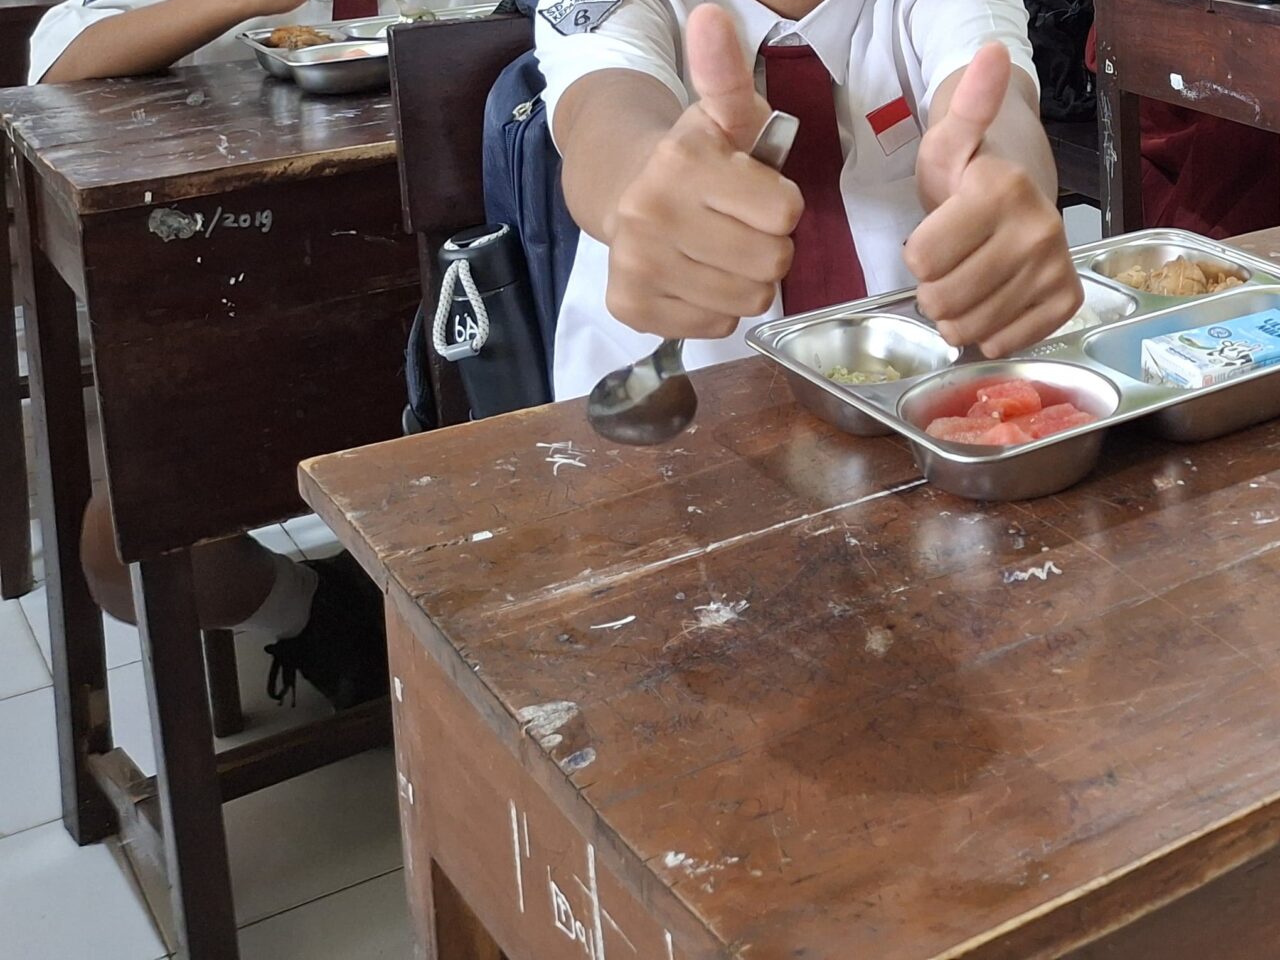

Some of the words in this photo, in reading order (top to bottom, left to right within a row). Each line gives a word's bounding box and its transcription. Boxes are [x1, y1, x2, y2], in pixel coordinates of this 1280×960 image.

[546, 4, 564, 16] SD
[573, 8, 591, 26] 6
[454, 313, 479, 343] 6A
